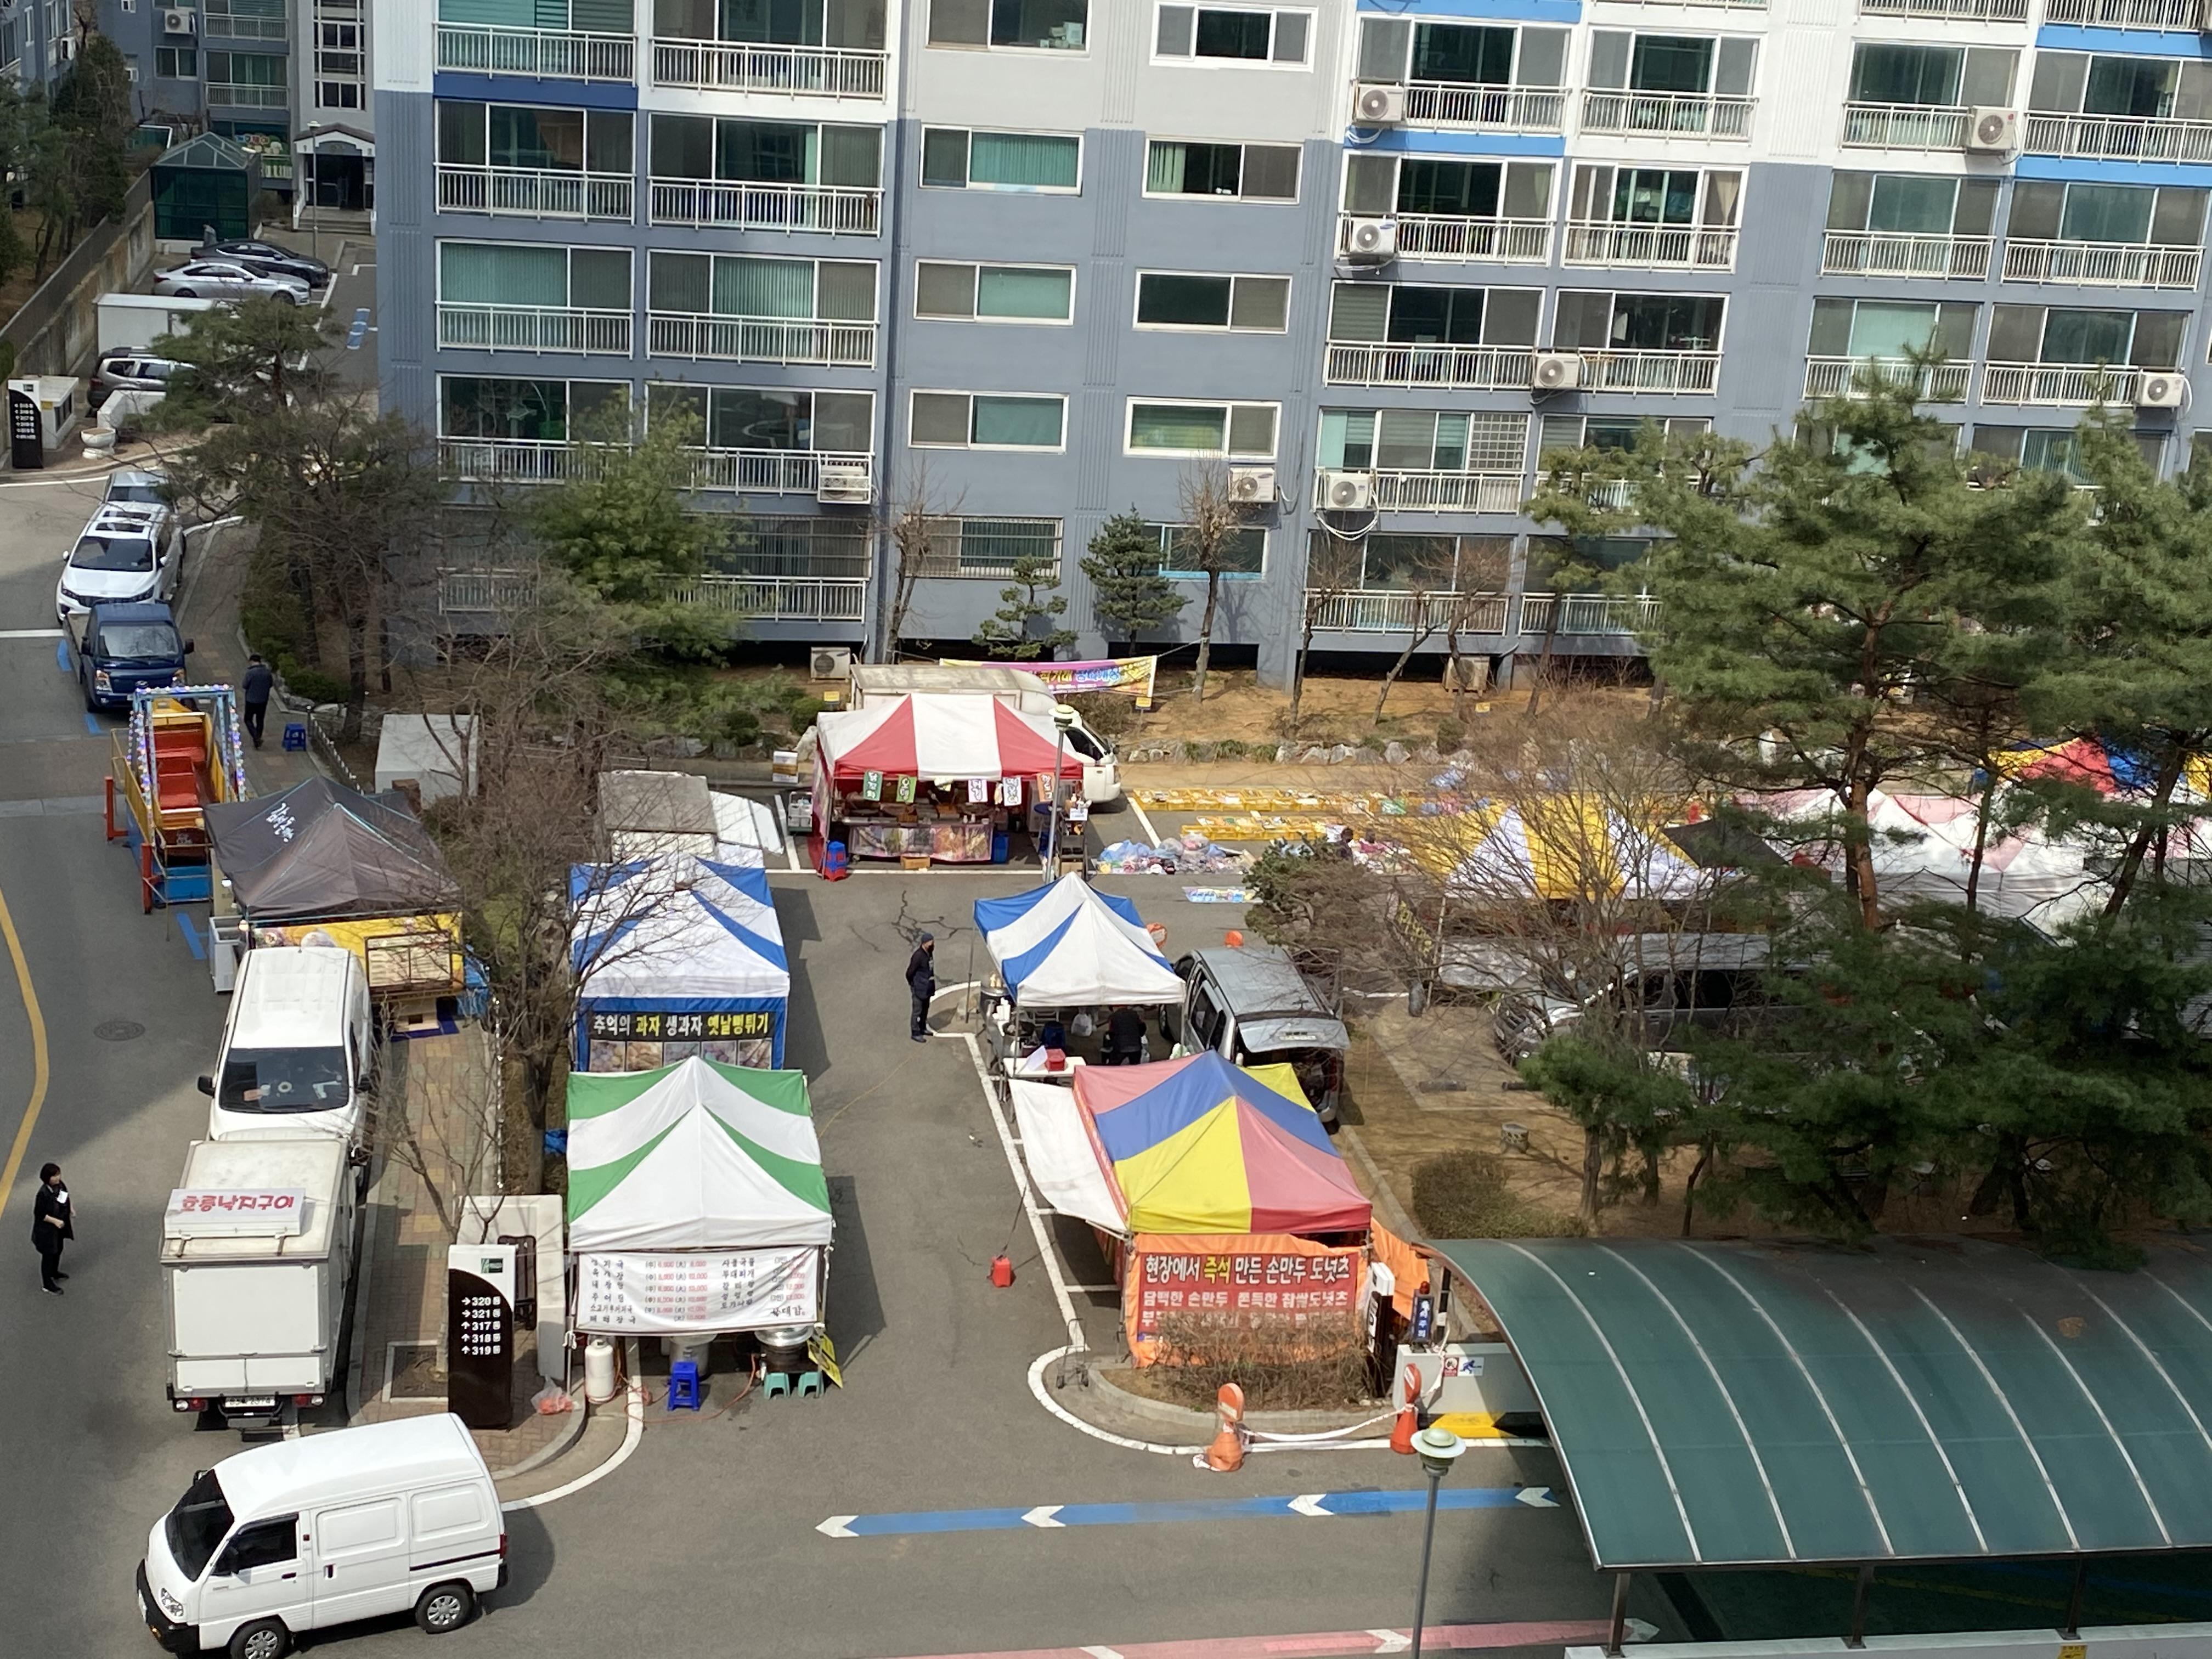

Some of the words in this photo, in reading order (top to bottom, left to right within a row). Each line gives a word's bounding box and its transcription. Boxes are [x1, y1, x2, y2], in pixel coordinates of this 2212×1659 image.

[594, 1014, 630, 1036] 추억의
[636, 1014, 661, 1036] 과자
[665, 1013, 703, 1036] 생과자
[707, 1012, 769, 1036] 옛날뻥튀기
[182, 1194, 295, 1212] 호롱낙지구이
[1146, 1254, 1201, 1284] 현장에서
[1204, 1255, 1232, 1284] 즉석
[1234, 1255, 1262, 1285] 만든
[1265, 1255, 1307, 1285] 손만두
[1309, 1254, 1350, 1284] 도넛츠
[1143, 1291, 1184, 1307] 담백한
[1188, 1291, 1228, 1307] 손만두
[1238, 1291, 1278, 1308] 쫀득한
[1282, 1291, 1348, 1308] 찹쌀도넛츠
